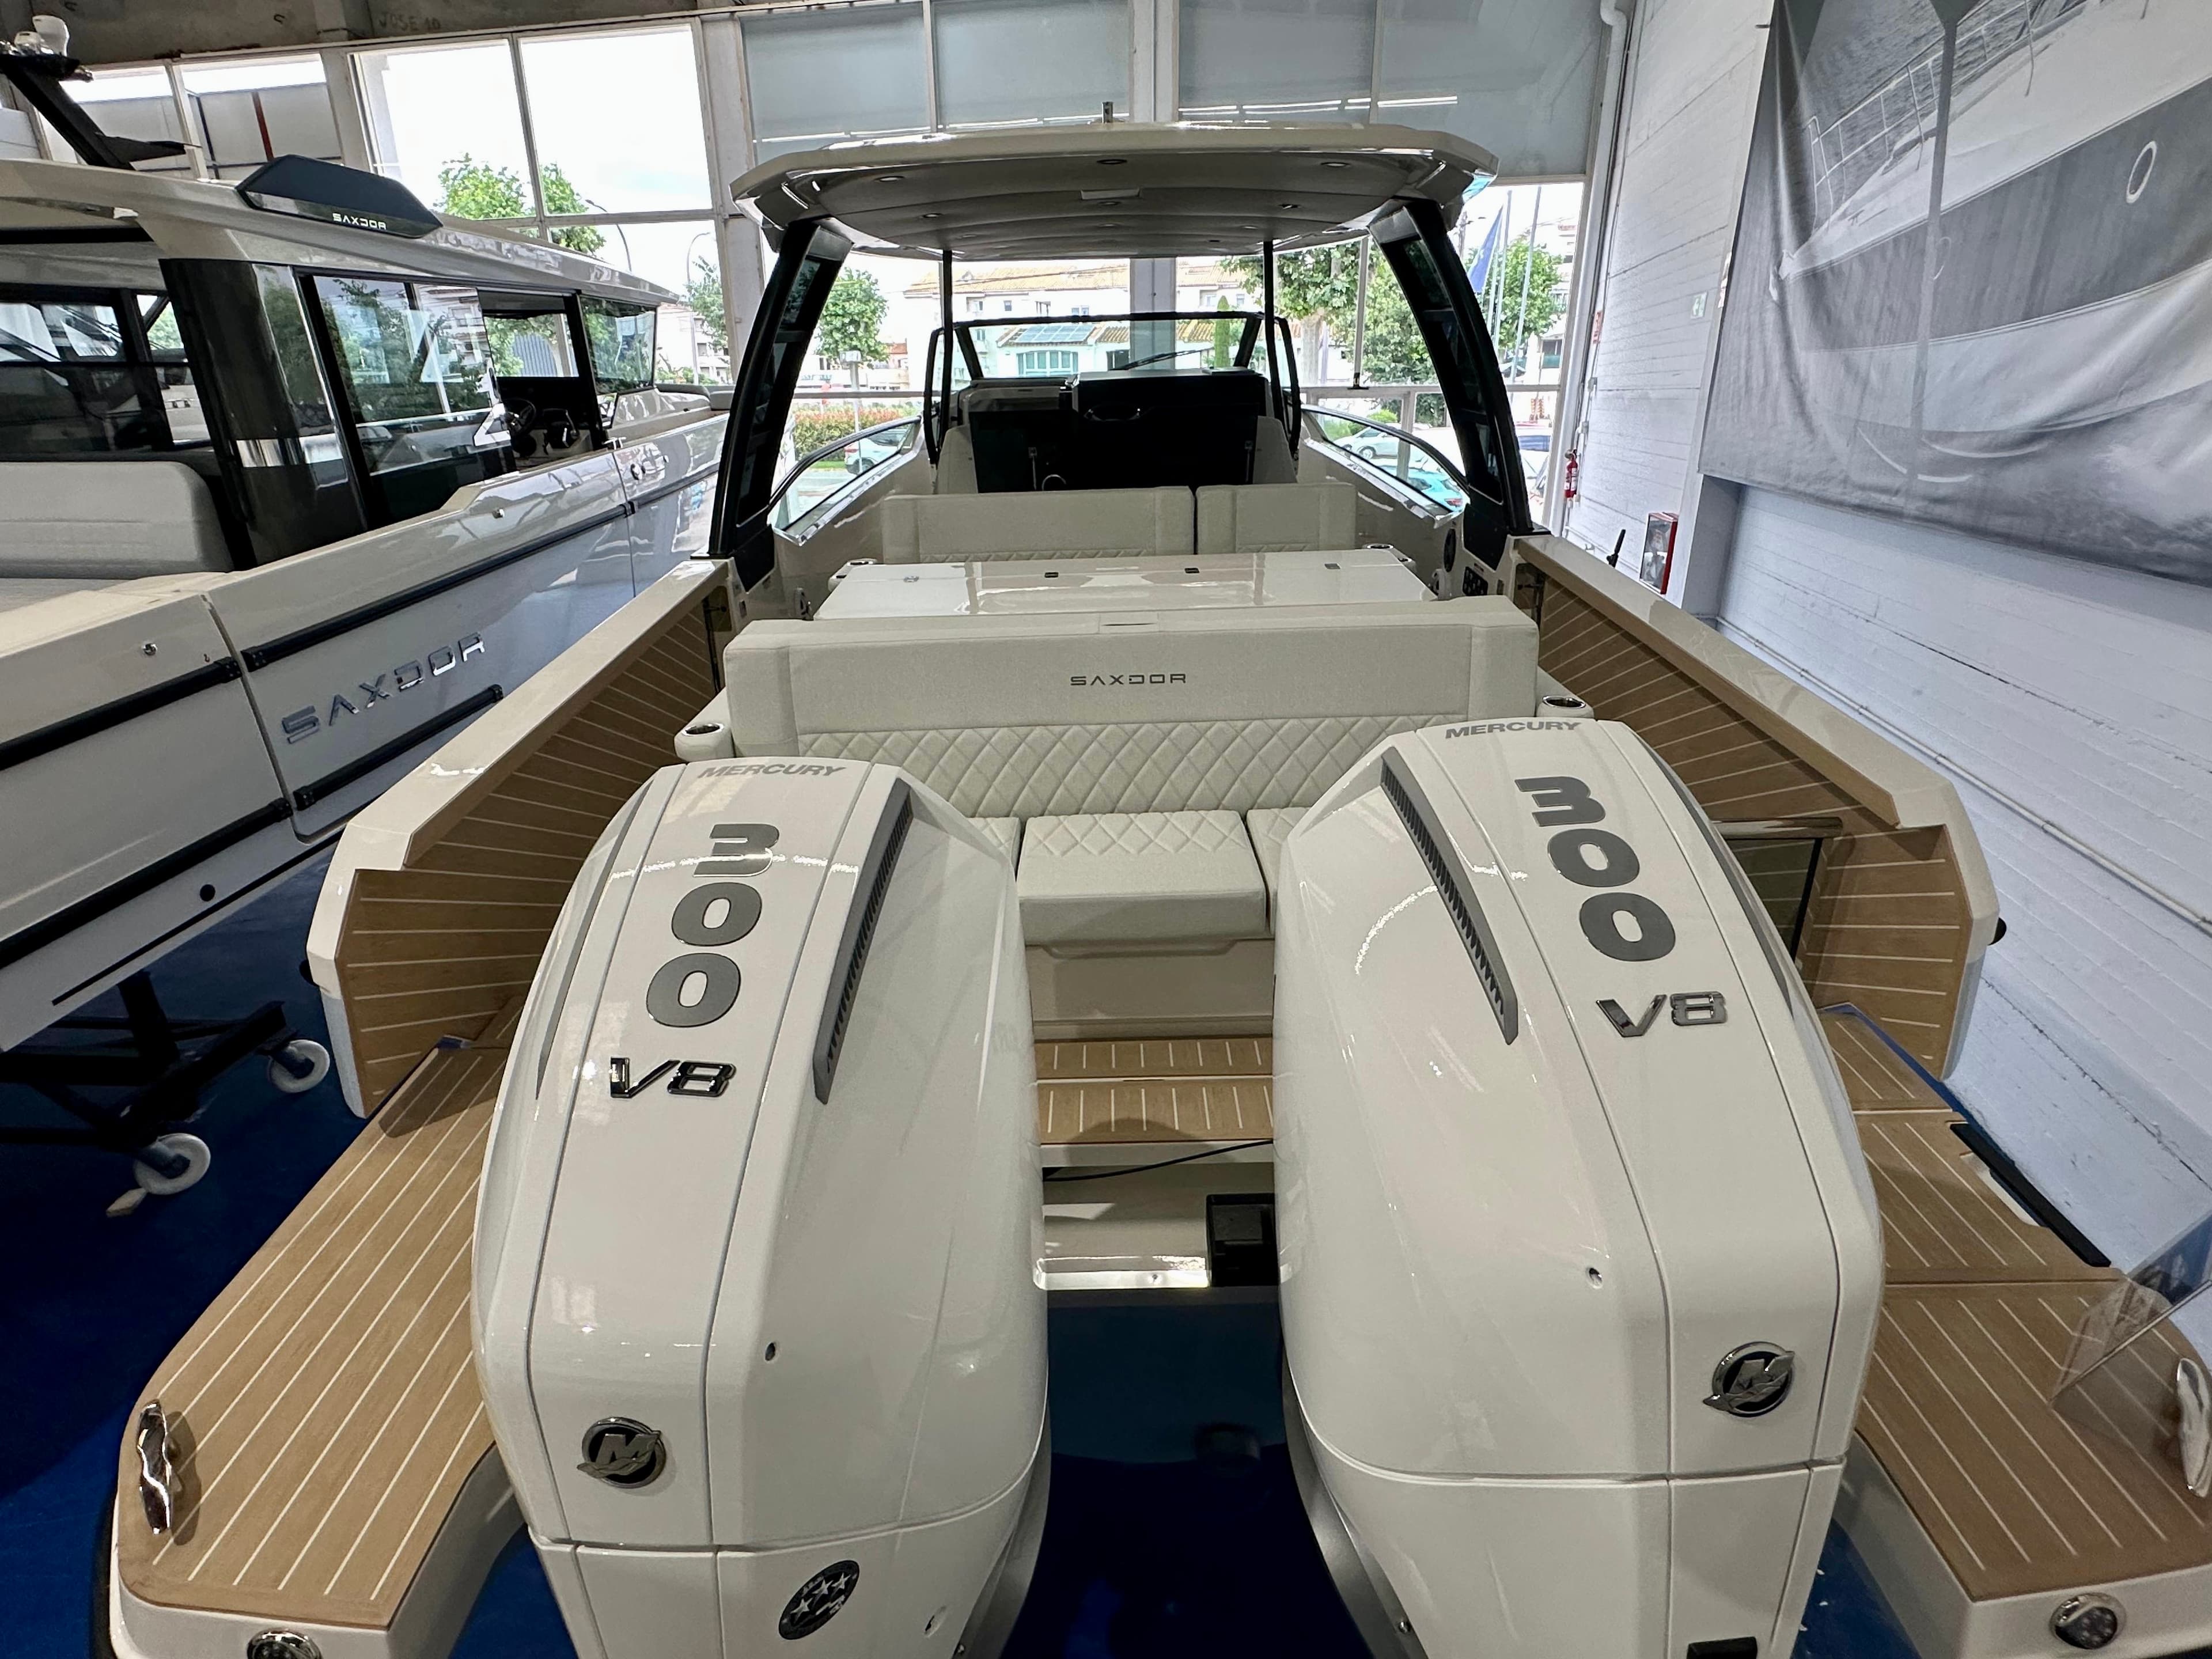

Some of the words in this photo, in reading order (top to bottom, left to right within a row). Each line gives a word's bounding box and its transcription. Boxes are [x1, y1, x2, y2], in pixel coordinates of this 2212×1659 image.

[332, 213, 387, 230] SAXDOR
[282, 632, 485, 744] SAXDOR
[1070, 673, 1186, 685] SAXDOR
[1445, 721, 1581, 739] MERCURY
[698, 764, 846, 778] MERCURY
[1514, 776, 1676, 962] 300
[646, 823, 779, 1028] 300
[1596, 991, 1728, 1037] V8
[611, 1057, 736, 1098] V8
